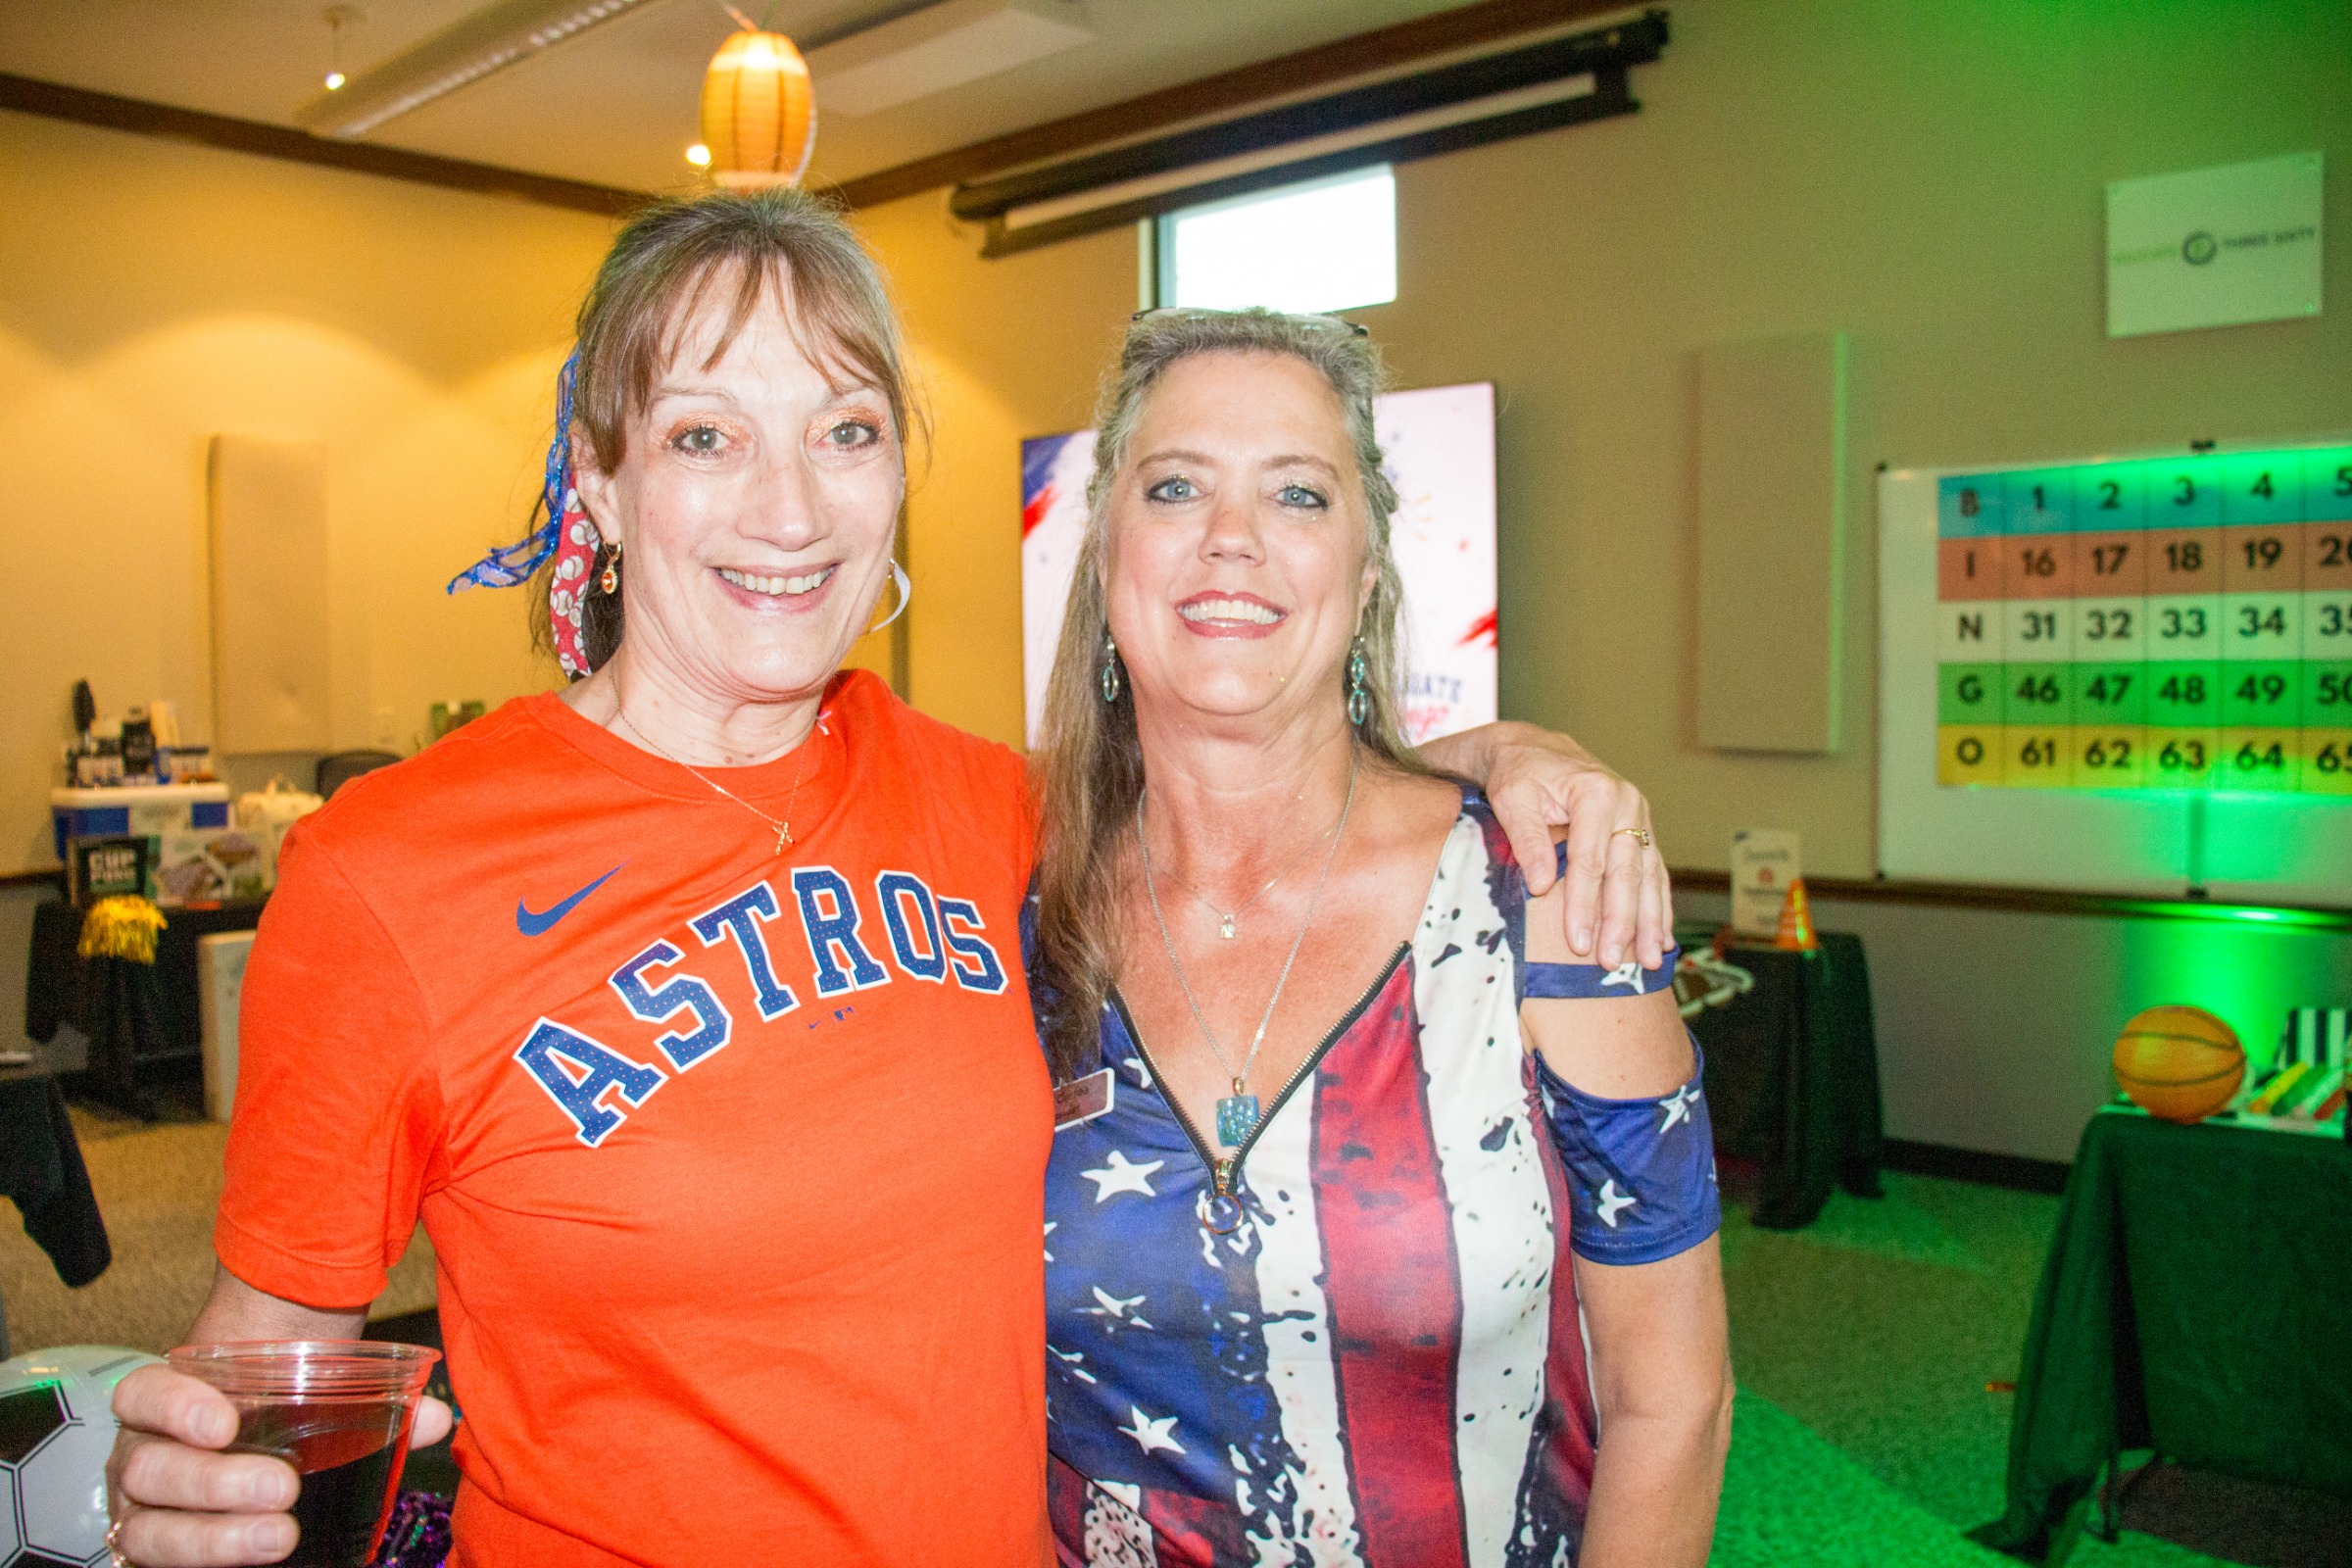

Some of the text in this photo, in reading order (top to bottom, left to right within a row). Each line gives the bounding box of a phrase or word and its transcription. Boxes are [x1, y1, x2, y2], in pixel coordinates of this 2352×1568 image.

[1959, 488, 1982, 517] B
[2032, 484, 2046, 514] 1
[2098, 480, 2121, 510] 2
[2173, 476, 2195, 507] 3
[2250, 472, 2274, 500] 4
[2022, 549, 2056, 577] 16
[2092, 544, 2130, 574] 17
[2166, 541, 2203, 572] 18
[2244, 537, 2283, 569] 19
[2319, 535, 2352, 566] 2
[1958, 613, 1984, 642] N
[2022, 612, 2056, 642] 31
[2086, 609, 2132, 641] 32
[2162, 608, 2207, 639] 33
[2239, 607, 2285, 637] 34
[1957, 674, 1984, 705] G
[2017, 675, 2060, 705] 46
[2086, 675, 2132, 705] 47
[2160, 674, 2206, 706] 48
[2236, 674, 2286, 705] 49
[1956, 737, 1984, 766] O
[2021, 738, 2056, 767] 61
[2083, 739, 2131, 768] 62
[2159, 740, 2206, 772] 63
[2236, 742, 2284, 772] 64
[513, 865, 1008, 1148] ASTROS
